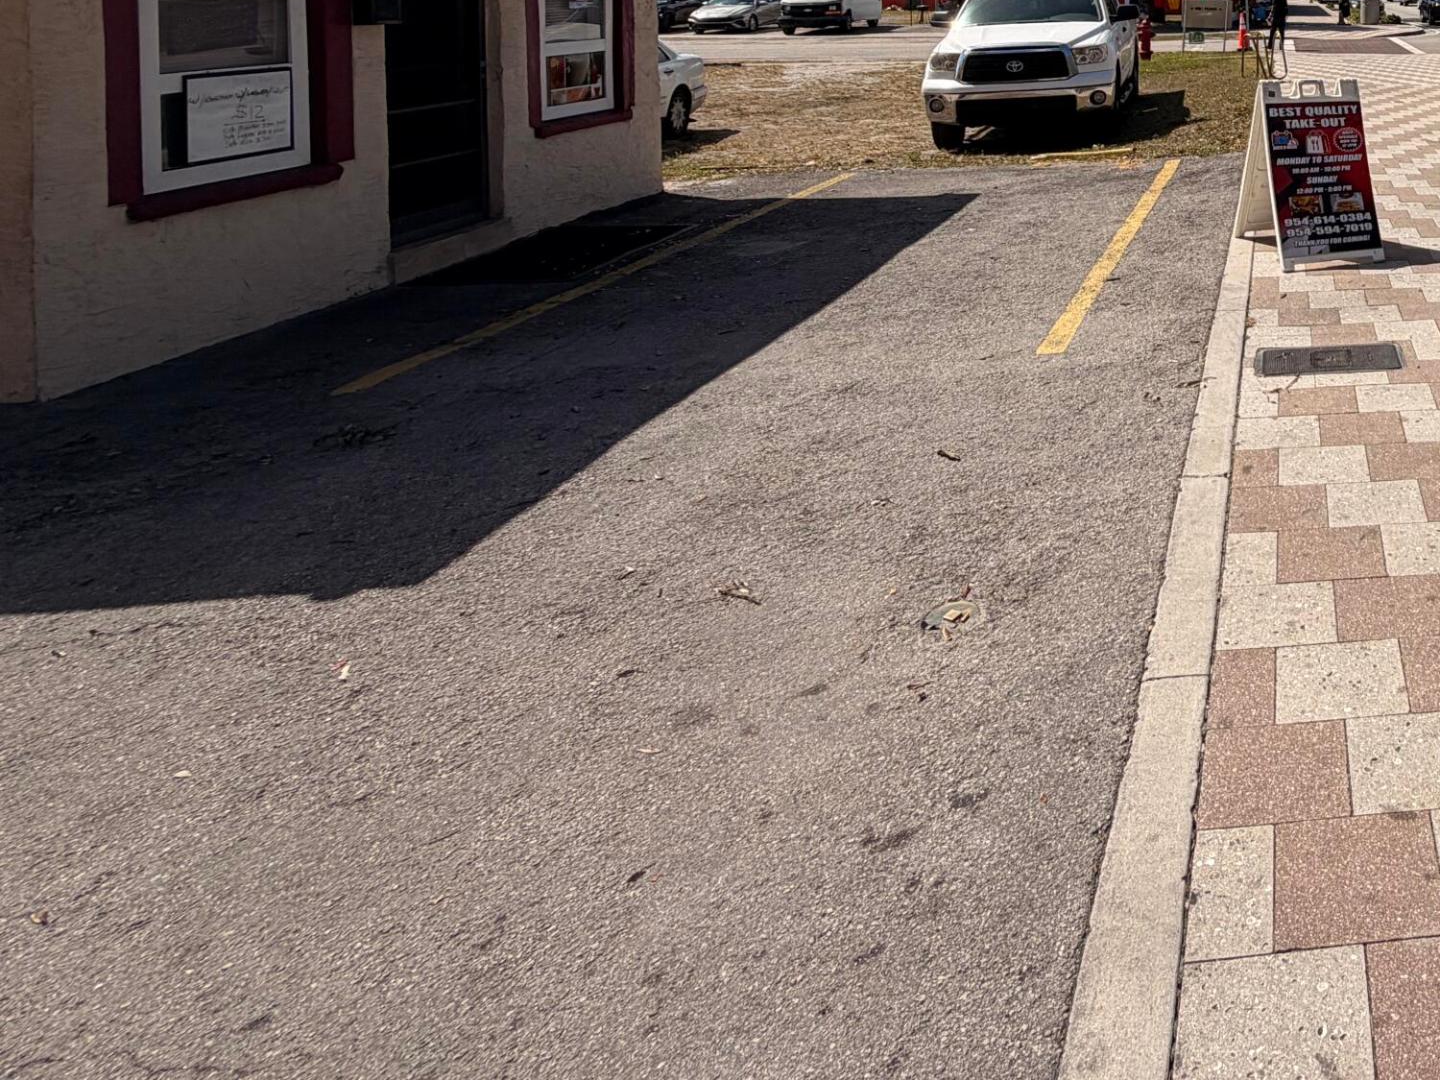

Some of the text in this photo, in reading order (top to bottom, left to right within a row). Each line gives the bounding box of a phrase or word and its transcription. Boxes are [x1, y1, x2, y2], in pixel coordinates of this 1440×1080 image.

[1269, 105, 1358, 118] BEST QUALITY
[1283, 117, 1346, 129] TAKE-OUT
[1276, 154, 1363, 166] MONDAY TO SATURDAY
[1306, 175, 1338, 184] SUNDAY
[1295, 239, 1315, 248] THANK
[1316, 238, 1329, 246] YOU
[1343, 235, 1371, 243] COMING!
